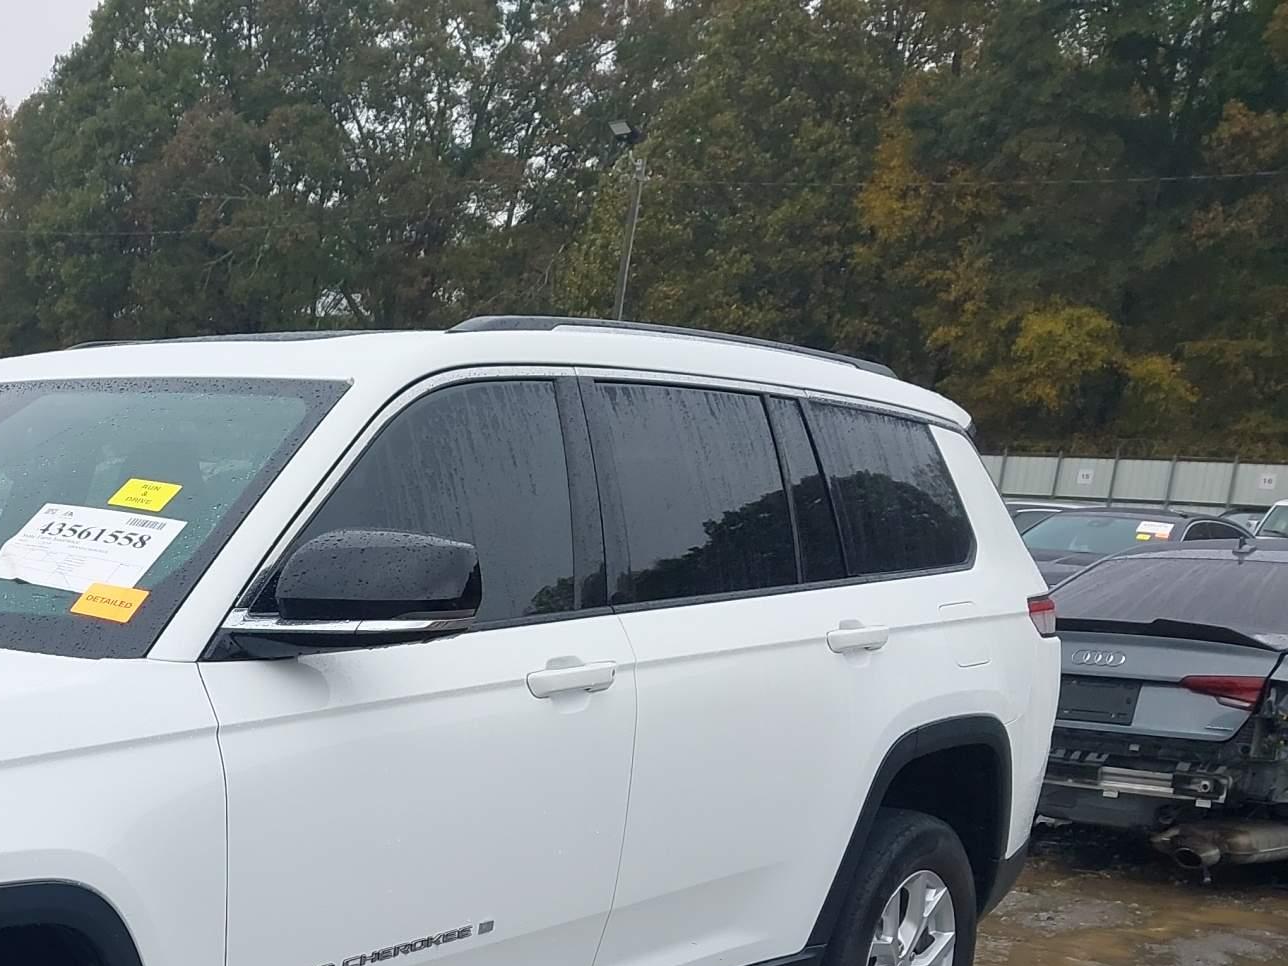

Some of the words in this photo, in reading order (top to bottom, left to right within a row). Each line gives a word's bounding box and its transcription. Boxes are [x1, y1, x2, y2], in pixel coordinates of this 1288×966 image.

[141, 484, 161, 492] RUN
[124, 496, 152, 505] DRIVE
[39, 520, 152, 549] 43561558
[86, 594, 133, 609] DETAILED
